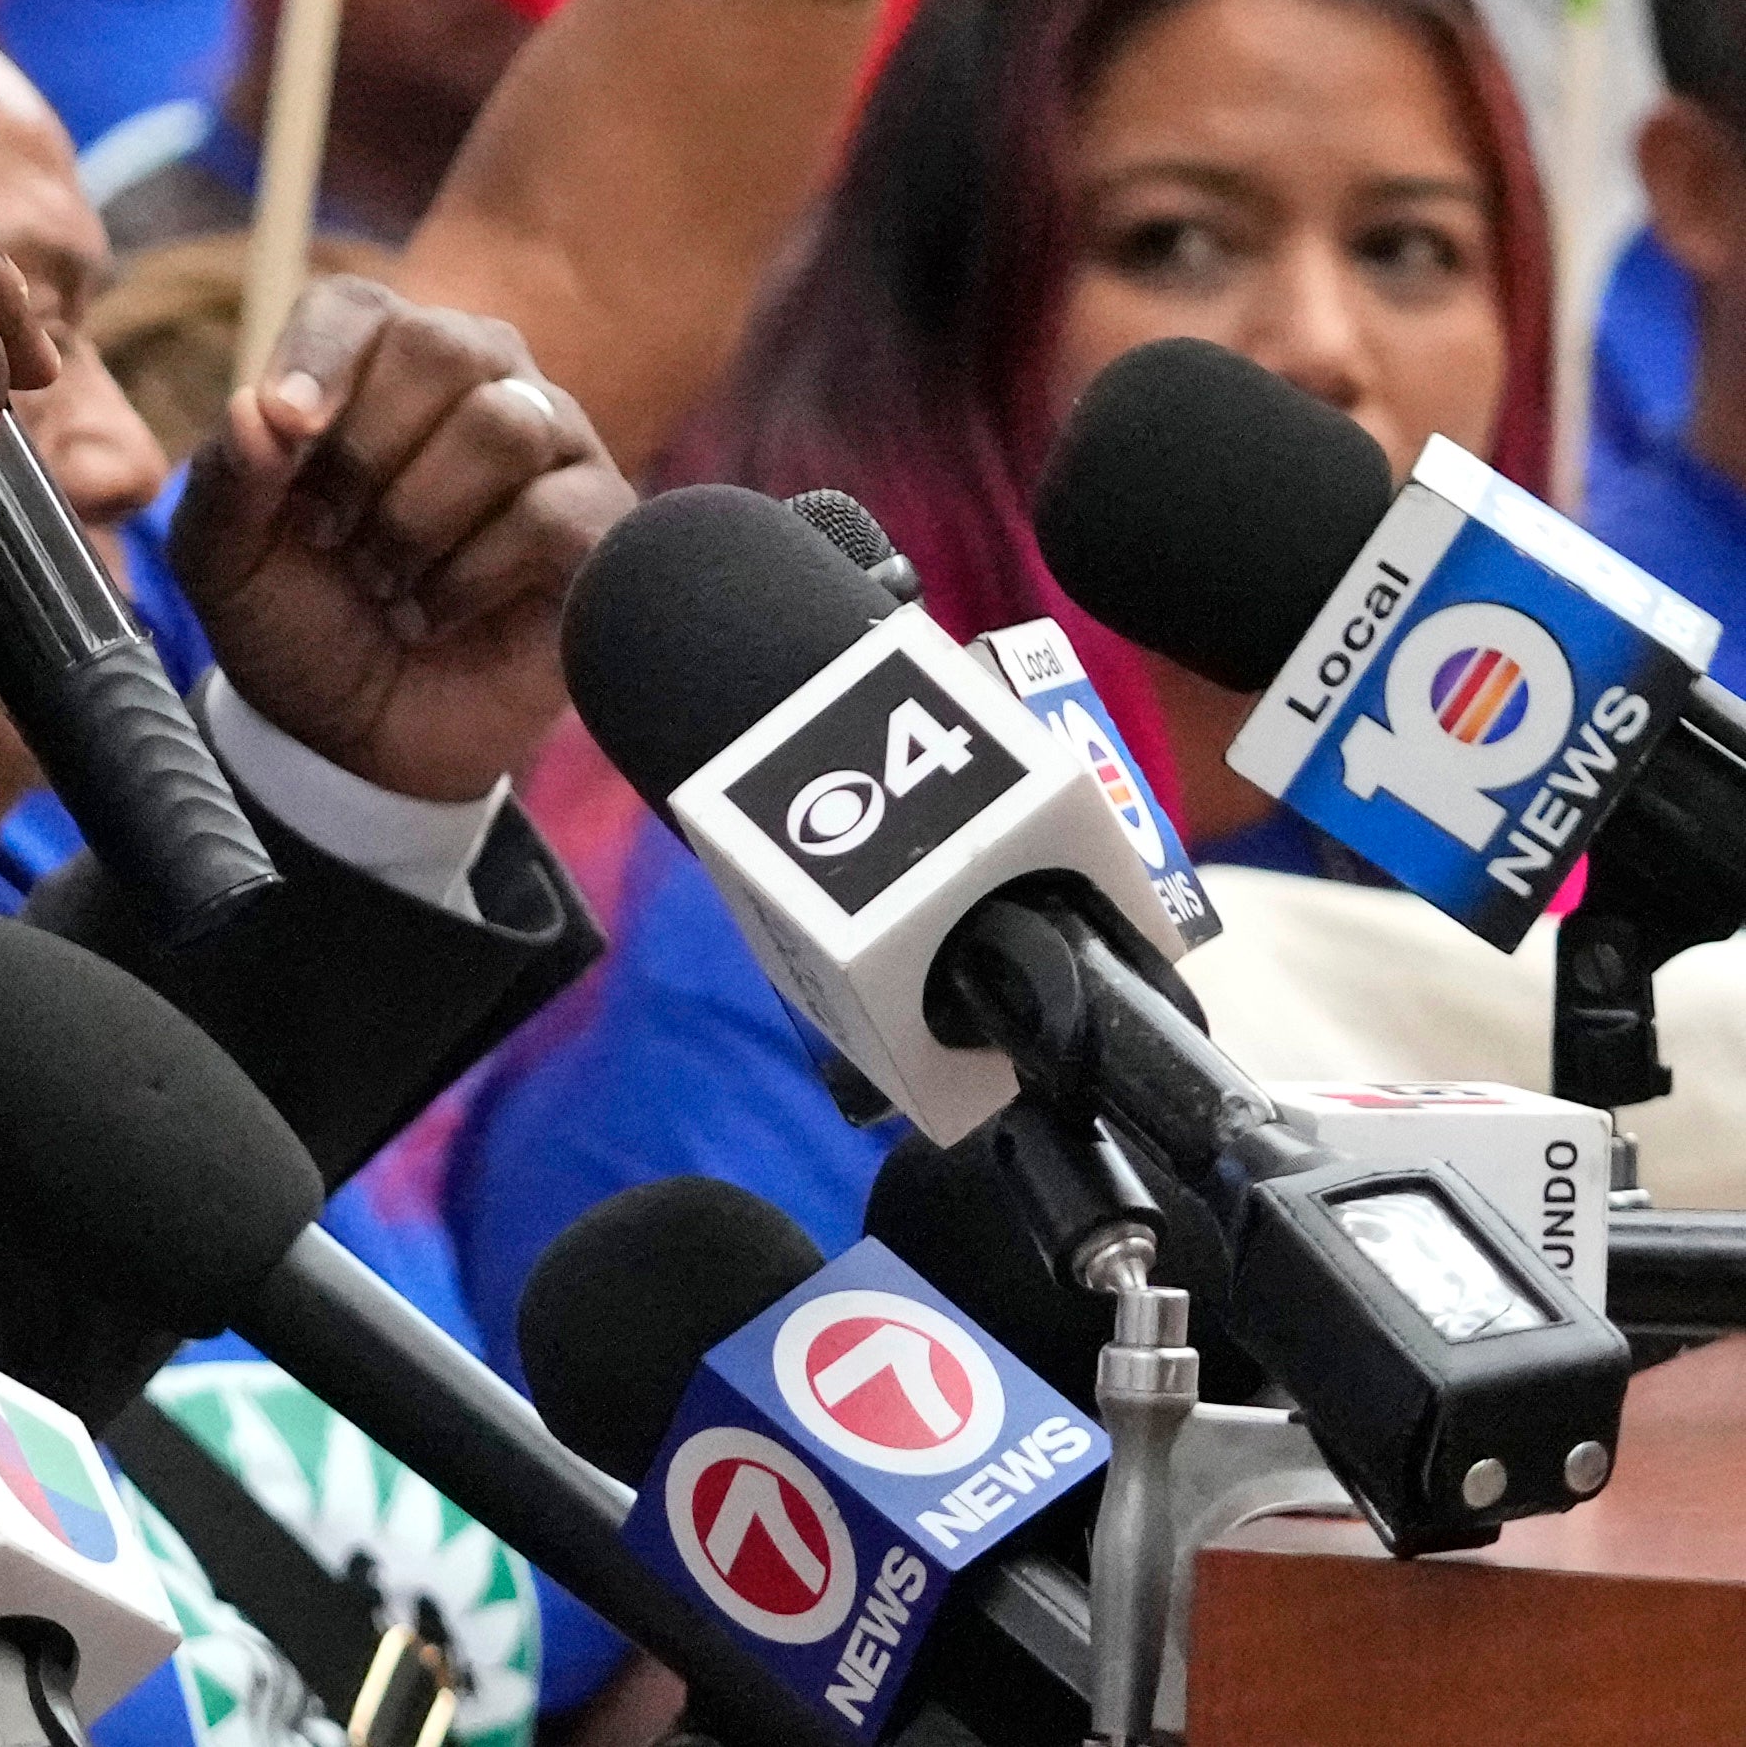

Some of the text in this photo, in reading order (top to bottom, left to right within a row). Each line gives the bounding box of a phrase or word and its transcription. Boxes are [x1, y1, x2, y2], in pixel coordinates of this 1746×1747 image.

[1012, 638, 1065, 682] Local
[1285, 560, 1410, 725] Local
[1340, 602, 1575, 853] 10
[1485, 684, 1652, 898] NEWS
[1151, 869, 1206, 925] EWS
[813, 1323, 963, 1445] 7
[704, 1462, 826, 1596] 7
[915, 1414, 1094, 1551] NEWS
[823, 1544, 929, 1727] NEWS
